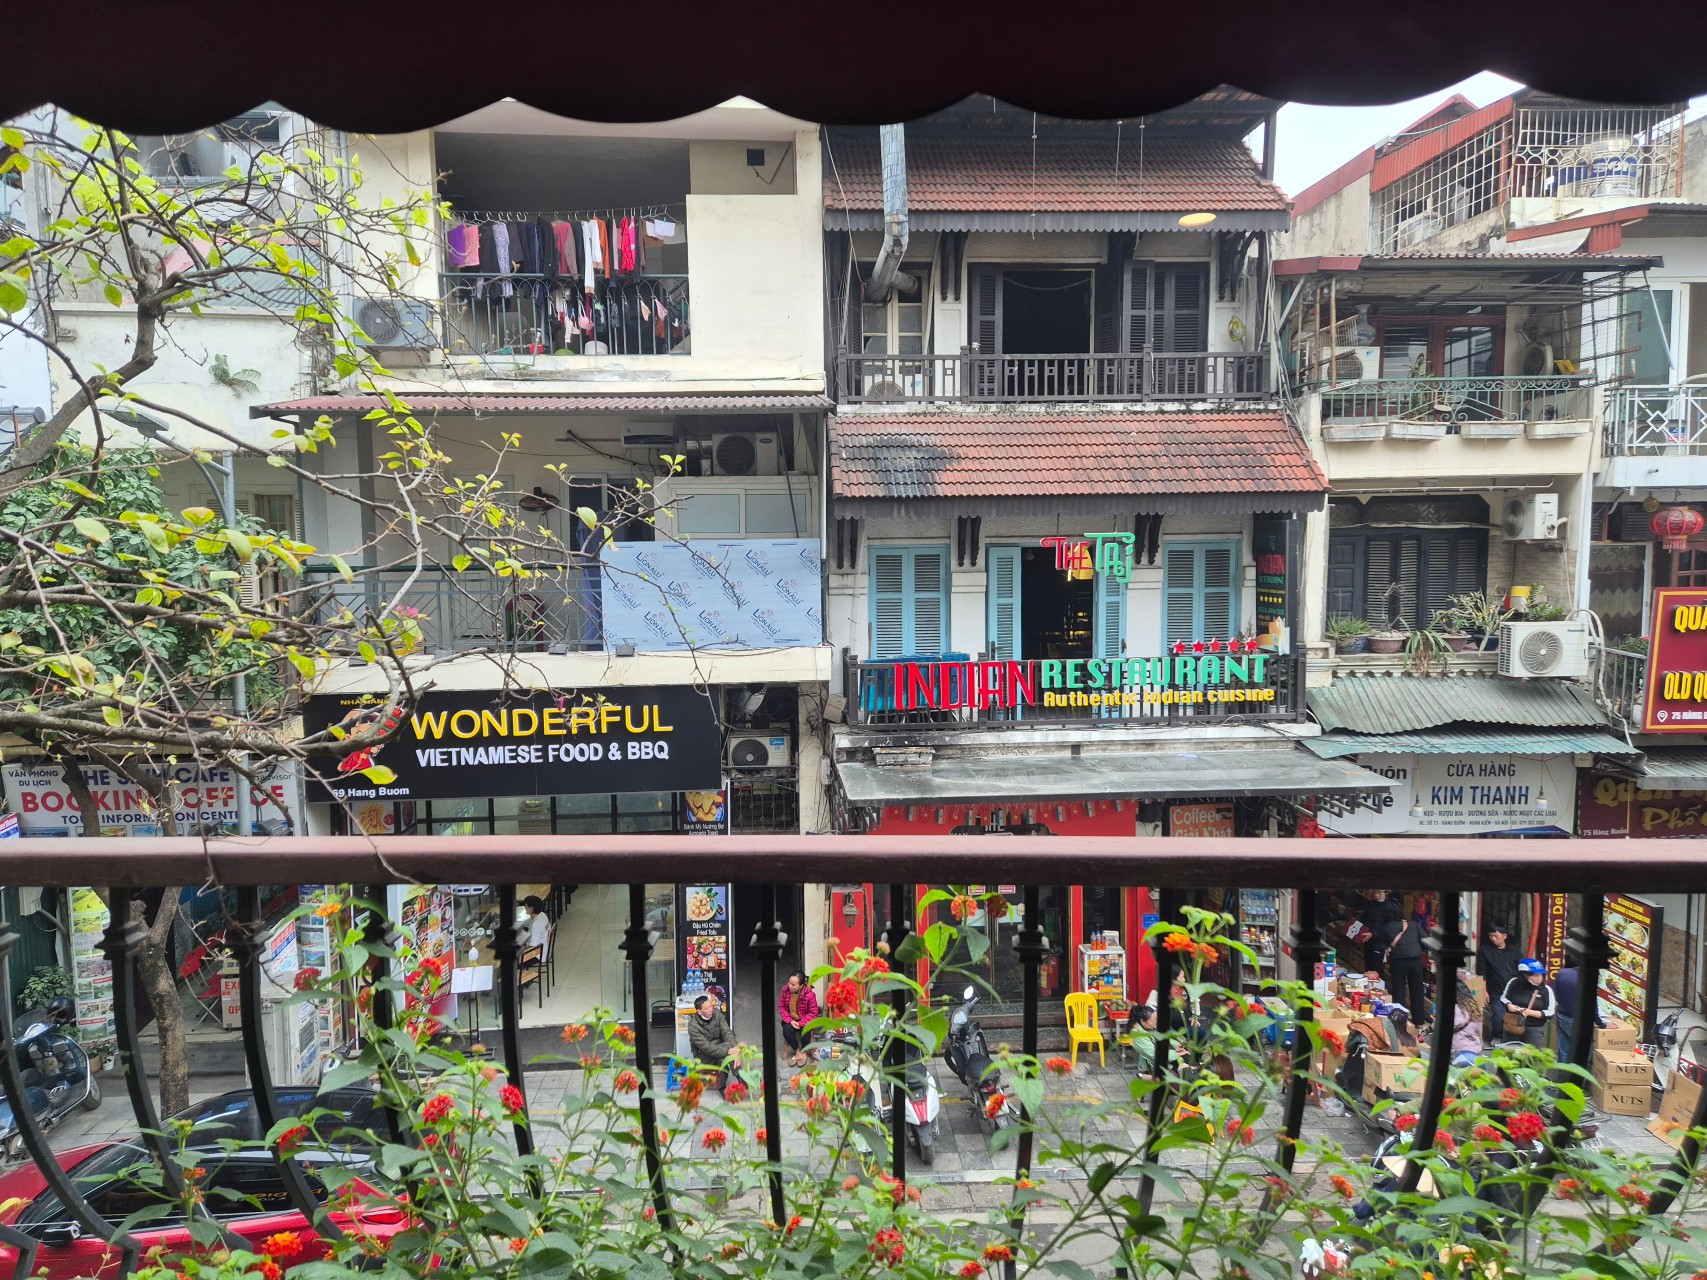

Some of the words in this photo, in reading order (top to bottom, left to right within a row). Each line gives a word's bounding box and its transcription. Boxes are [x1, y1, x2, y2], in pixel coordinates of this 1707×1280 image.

[1040, 536, 1091, 571] THE
[893, 659, 1036, 711] INDIAN
[1040, 654, 1270, 690] RESTAURANT
[1663, 671, 1692, 701] OLD
[1043, 689, 1138, 708] Authentic
[1207, 688, 1275, 704] cuisine
[410, 704, 674, 740] WONDERFUL
[1671, 711, 1681, 720] 75
[415, 744, 544, 768] VIETNAMESE
[547, 742, 603, 763] FOOD
[608, 741, 622, 761] &
[627, 740, 669, 761] BBQ
[28, 767, 59, 778] PHÒNG
[1446, 759, 1475, 777] CỬA
[1478, 760, 1516, 777] HÀNG
[18, 779, 31, 787] DU
[347, 787, 376, 799] Hang
[378, 786, 410, 796] Buom
[180, 785, 285, 809] OFFCE
[1431, 785, 1464, 805] KIM
[1469, 785, 1530, 805] THANH
[1173, 808, 1217, 826] Coffee
[1550, 919, 1563, 955] Town
[1615, 1064, 1647, 1075] NUTS
[1611, 1093, 1644, 1106] NUTS
